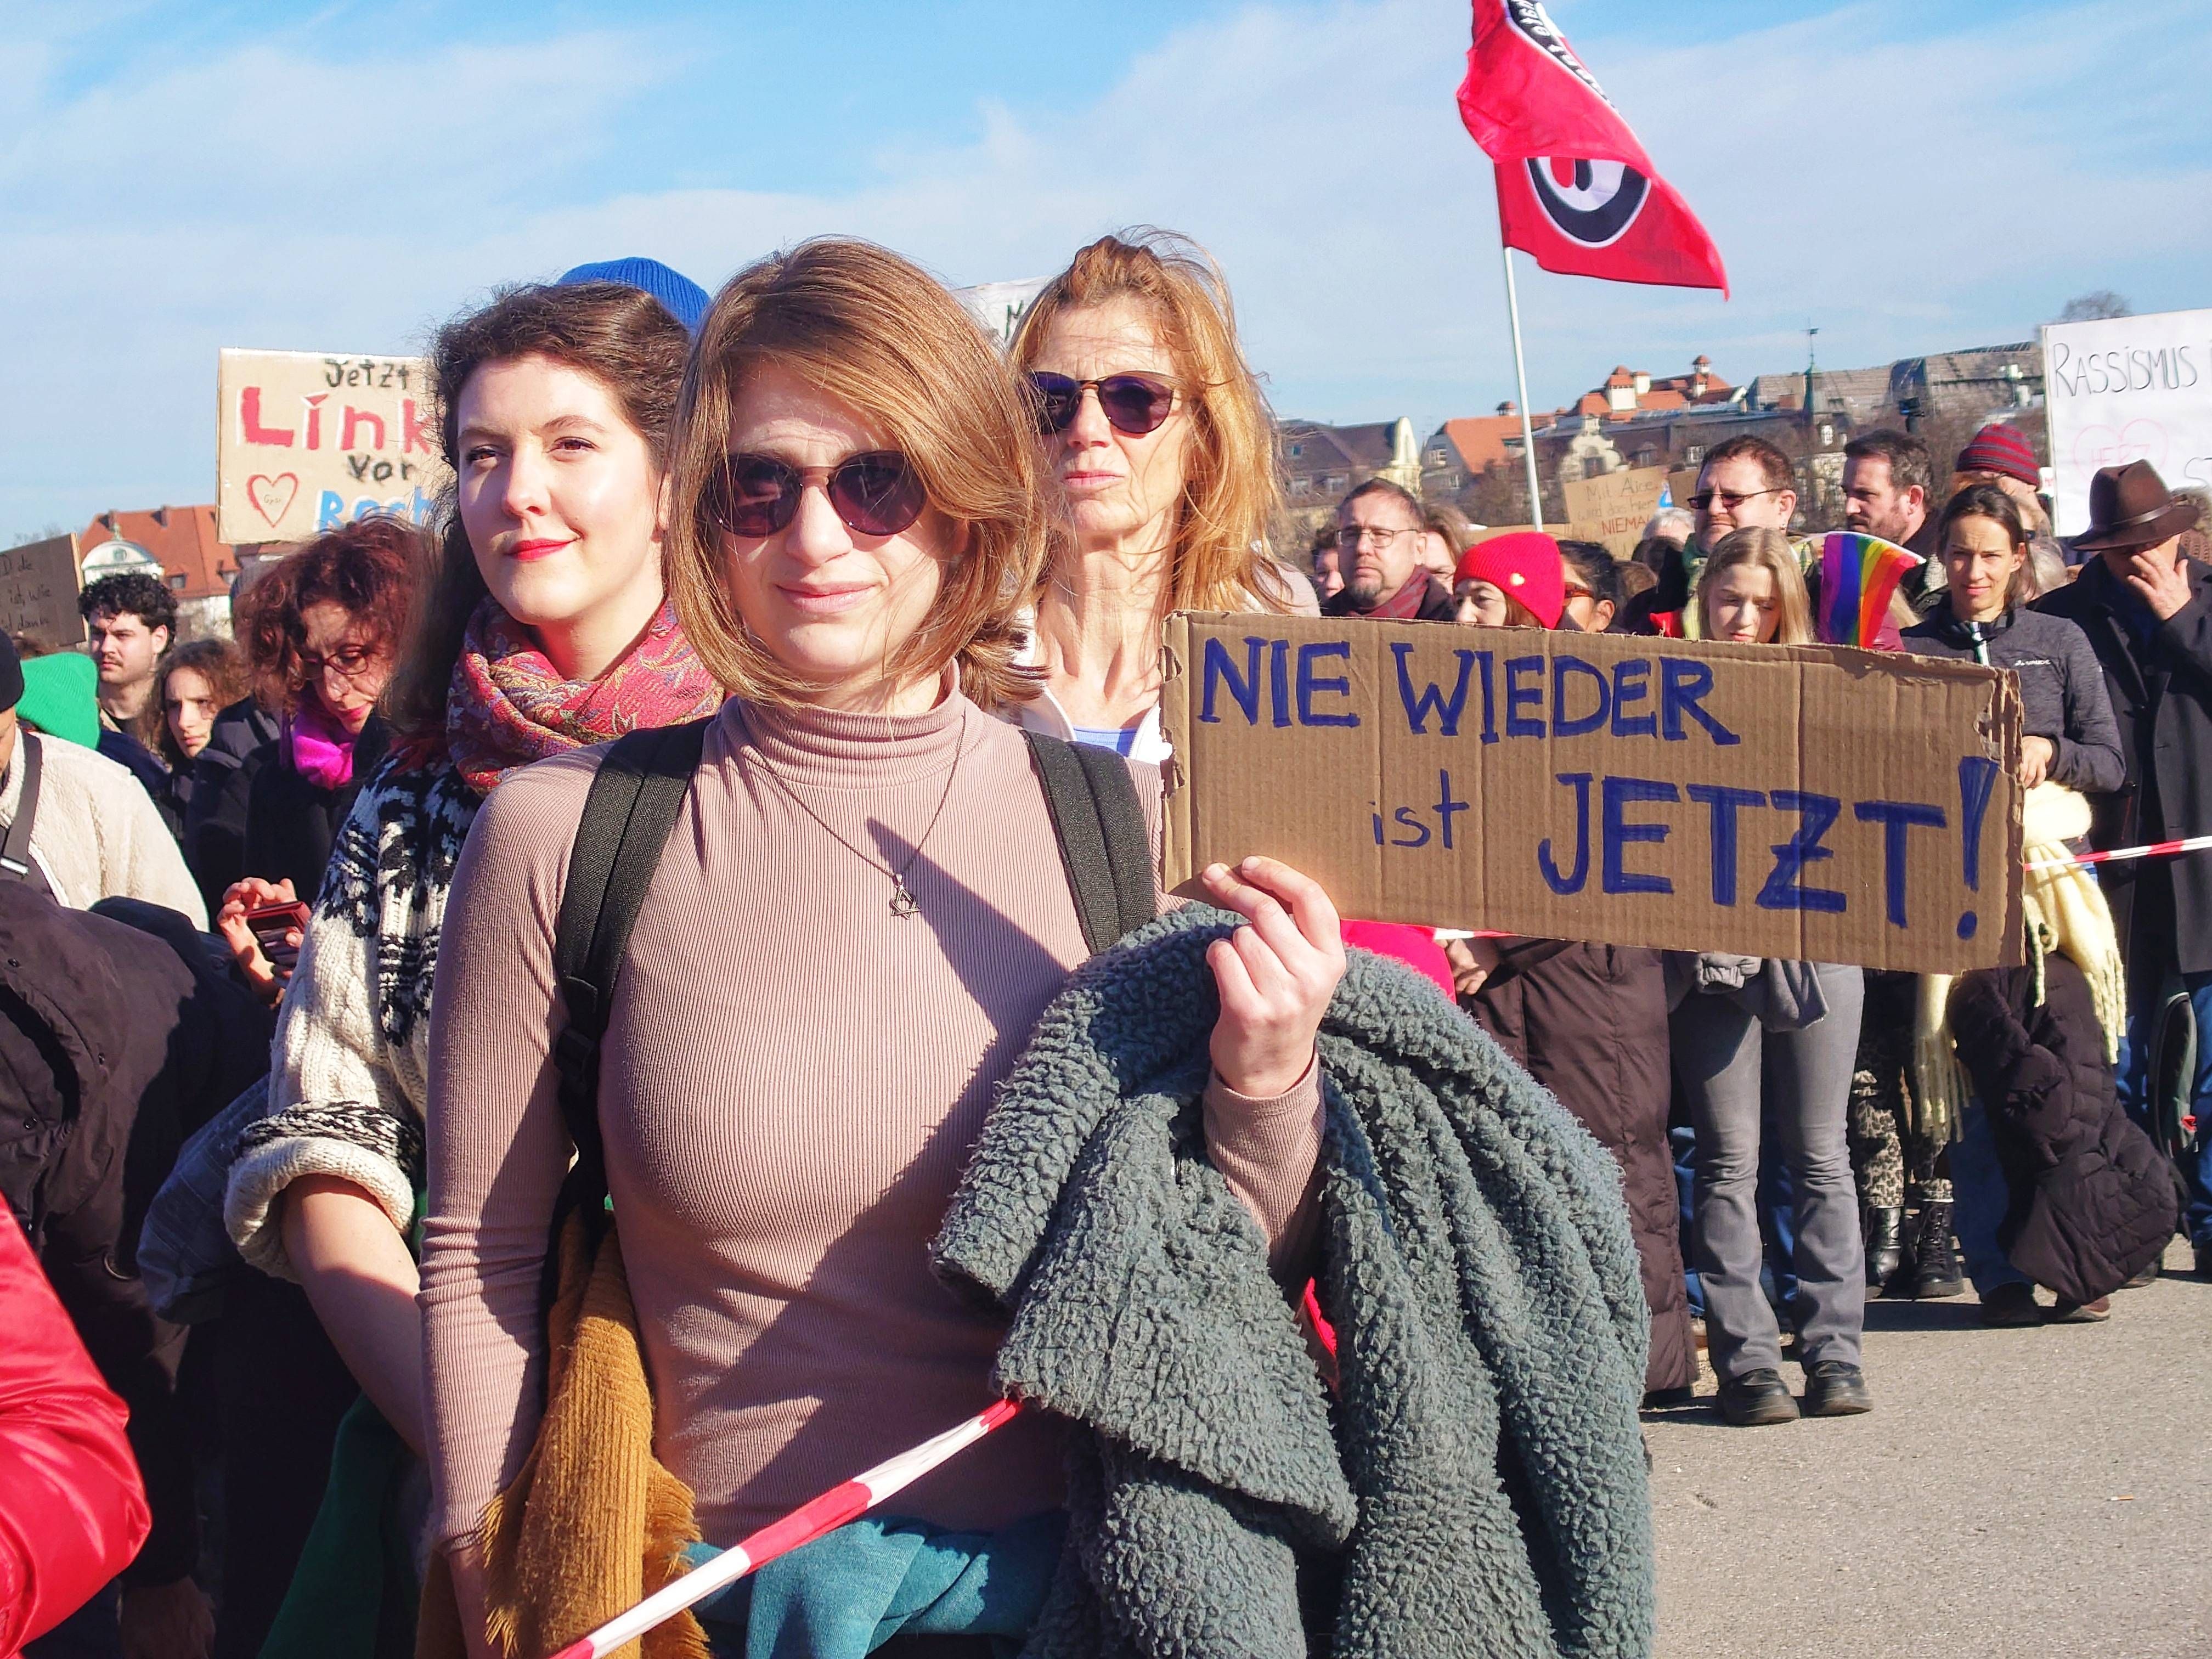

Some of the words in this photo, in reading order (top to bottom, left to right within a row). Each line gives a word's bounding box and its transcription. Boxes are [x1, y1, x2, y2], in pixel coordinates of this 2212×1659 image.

[240, 386, 433, 454] Link
[1601, 514, 1651, 536] NIEMA
[1198, 636, 1360, 727] NIE
[1390, 642, 1741, 746] WIEDER
[1373, 769, 1470, 849] ist
[1537, 756, 2000, 939] JETZT!
